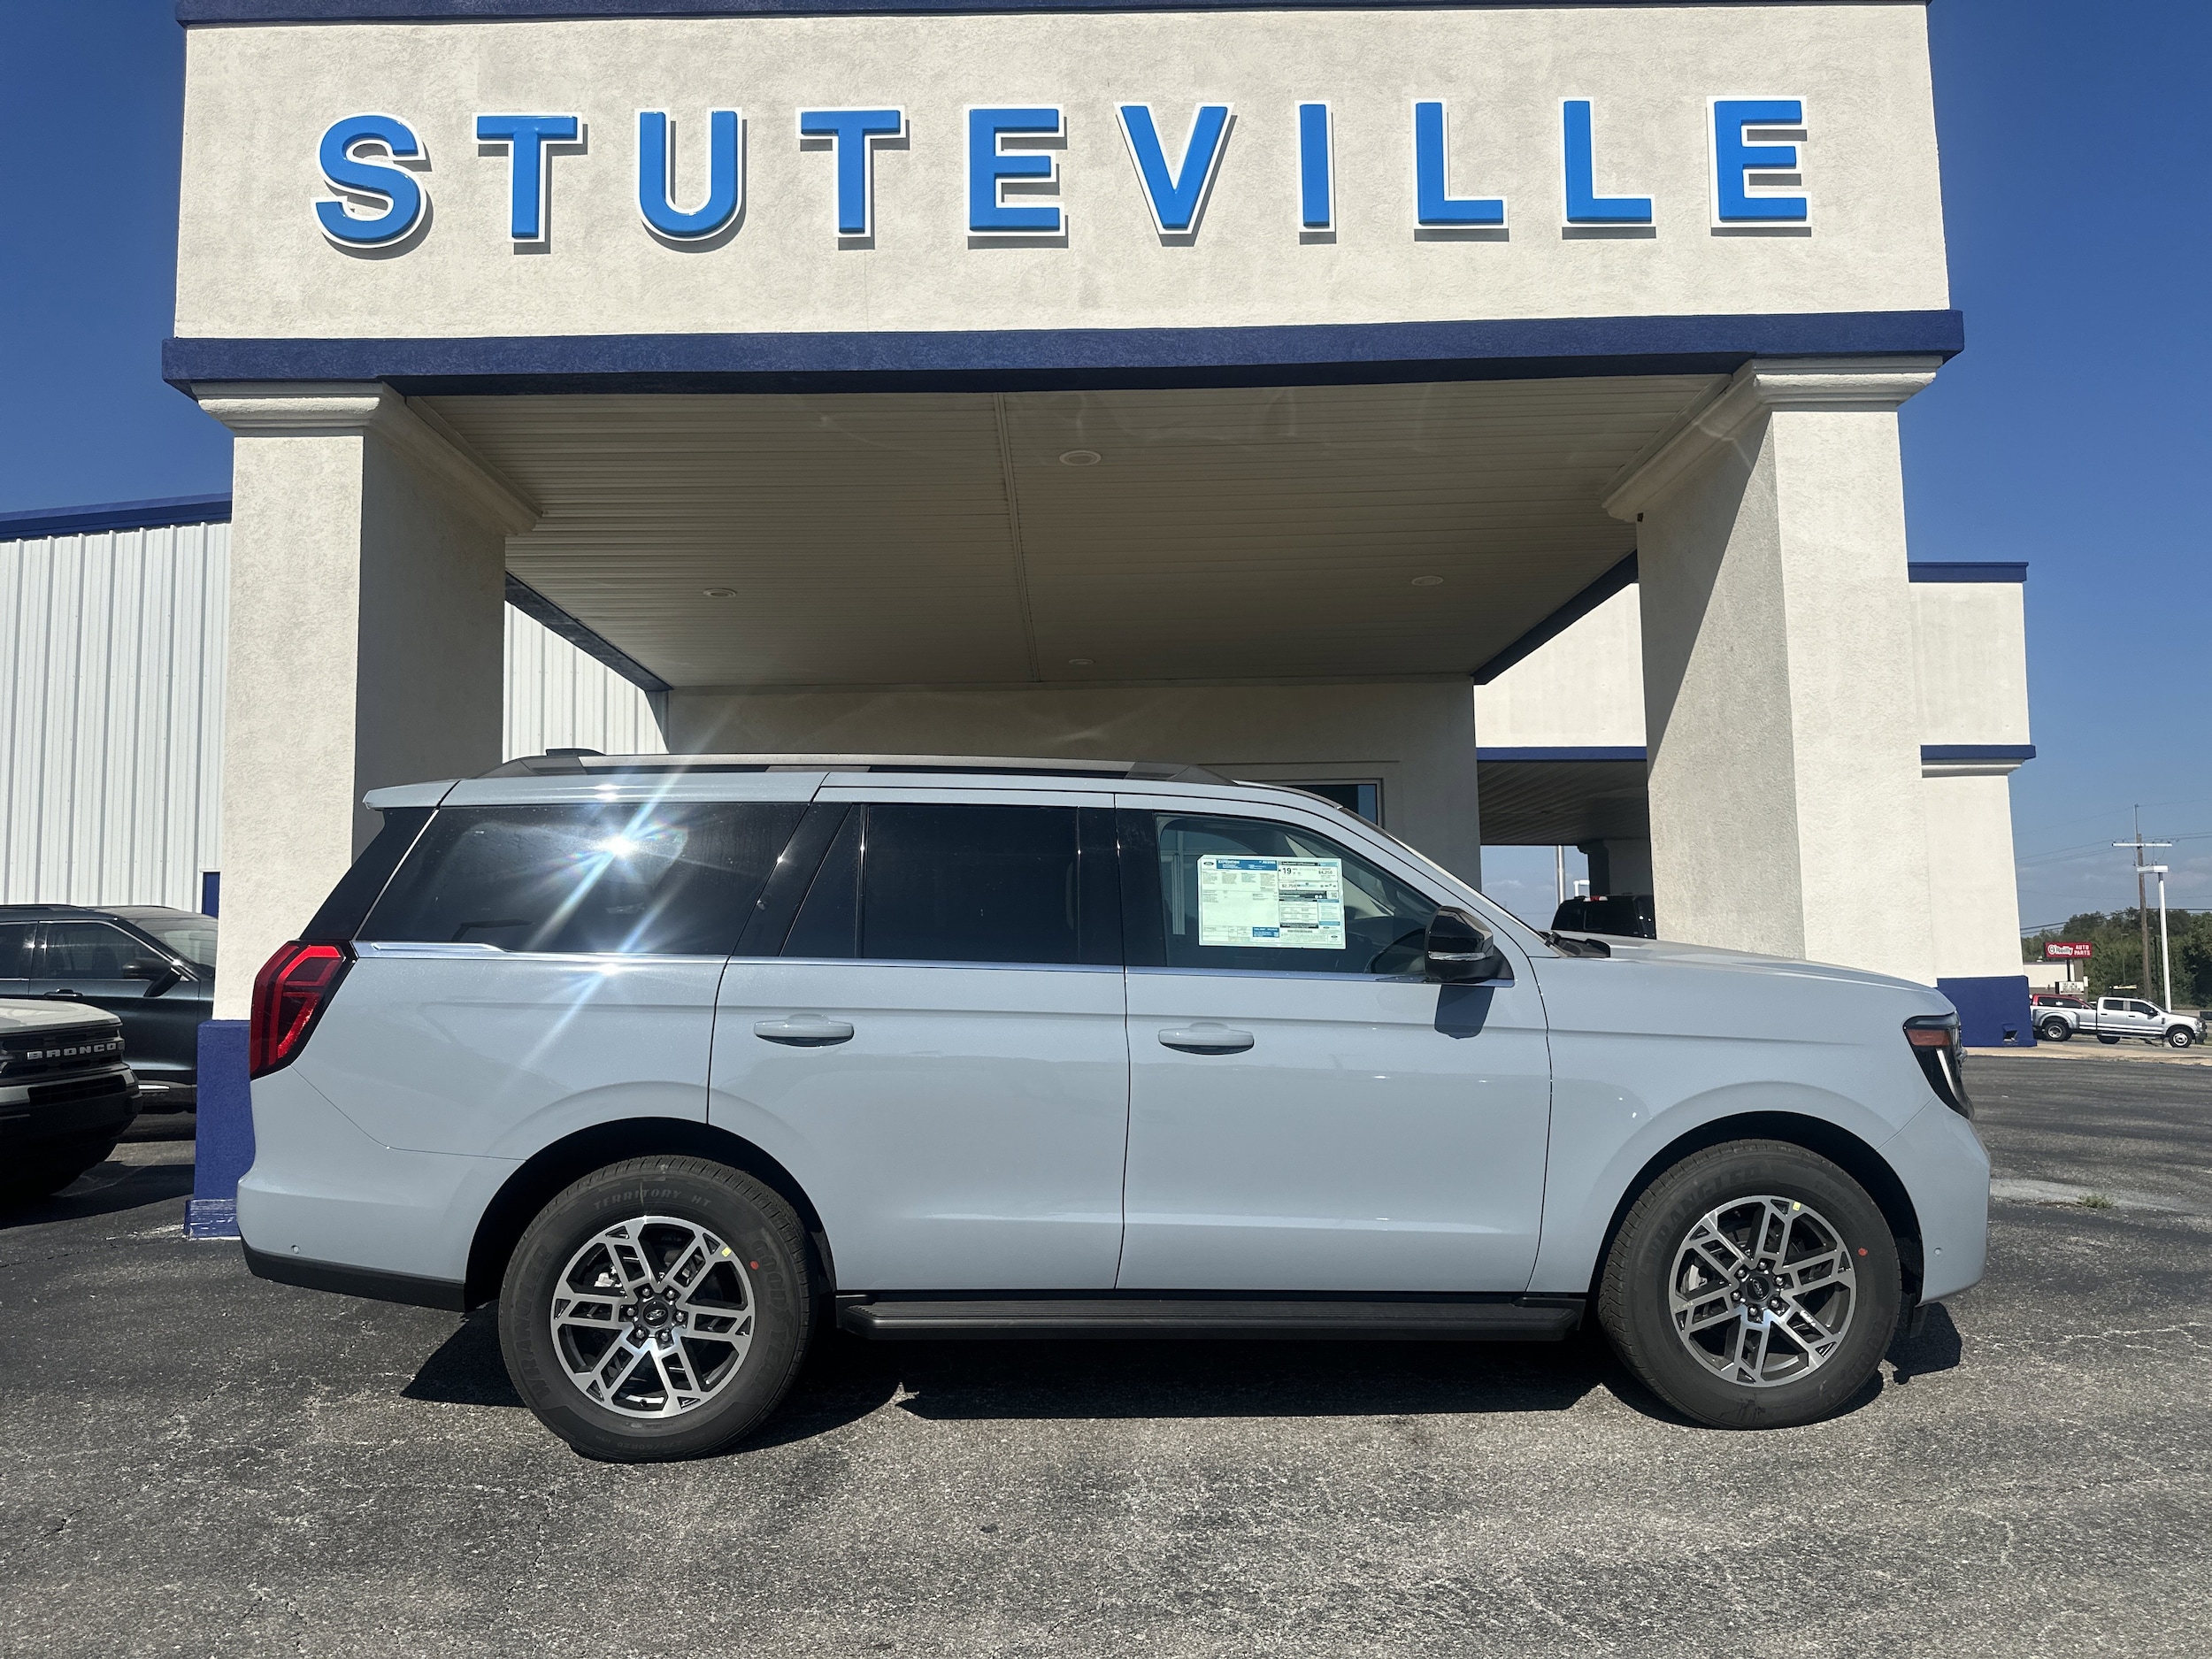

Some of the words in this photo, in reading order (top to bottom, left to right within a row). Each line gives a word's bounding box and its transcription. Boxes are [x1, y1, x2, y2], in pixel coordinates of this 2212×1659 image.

[311, 95, 1809, 250] STUTEVILLE
[27, 1042, 117, 1060] BRONCO
[593, 1188, 681, 1211] TERRITORY
[690, 1194, 712, 1208] HT
[514, 1244, 552, 1401] WRANGLER
[750, 1240, 791, 1396] GOODYEAR
